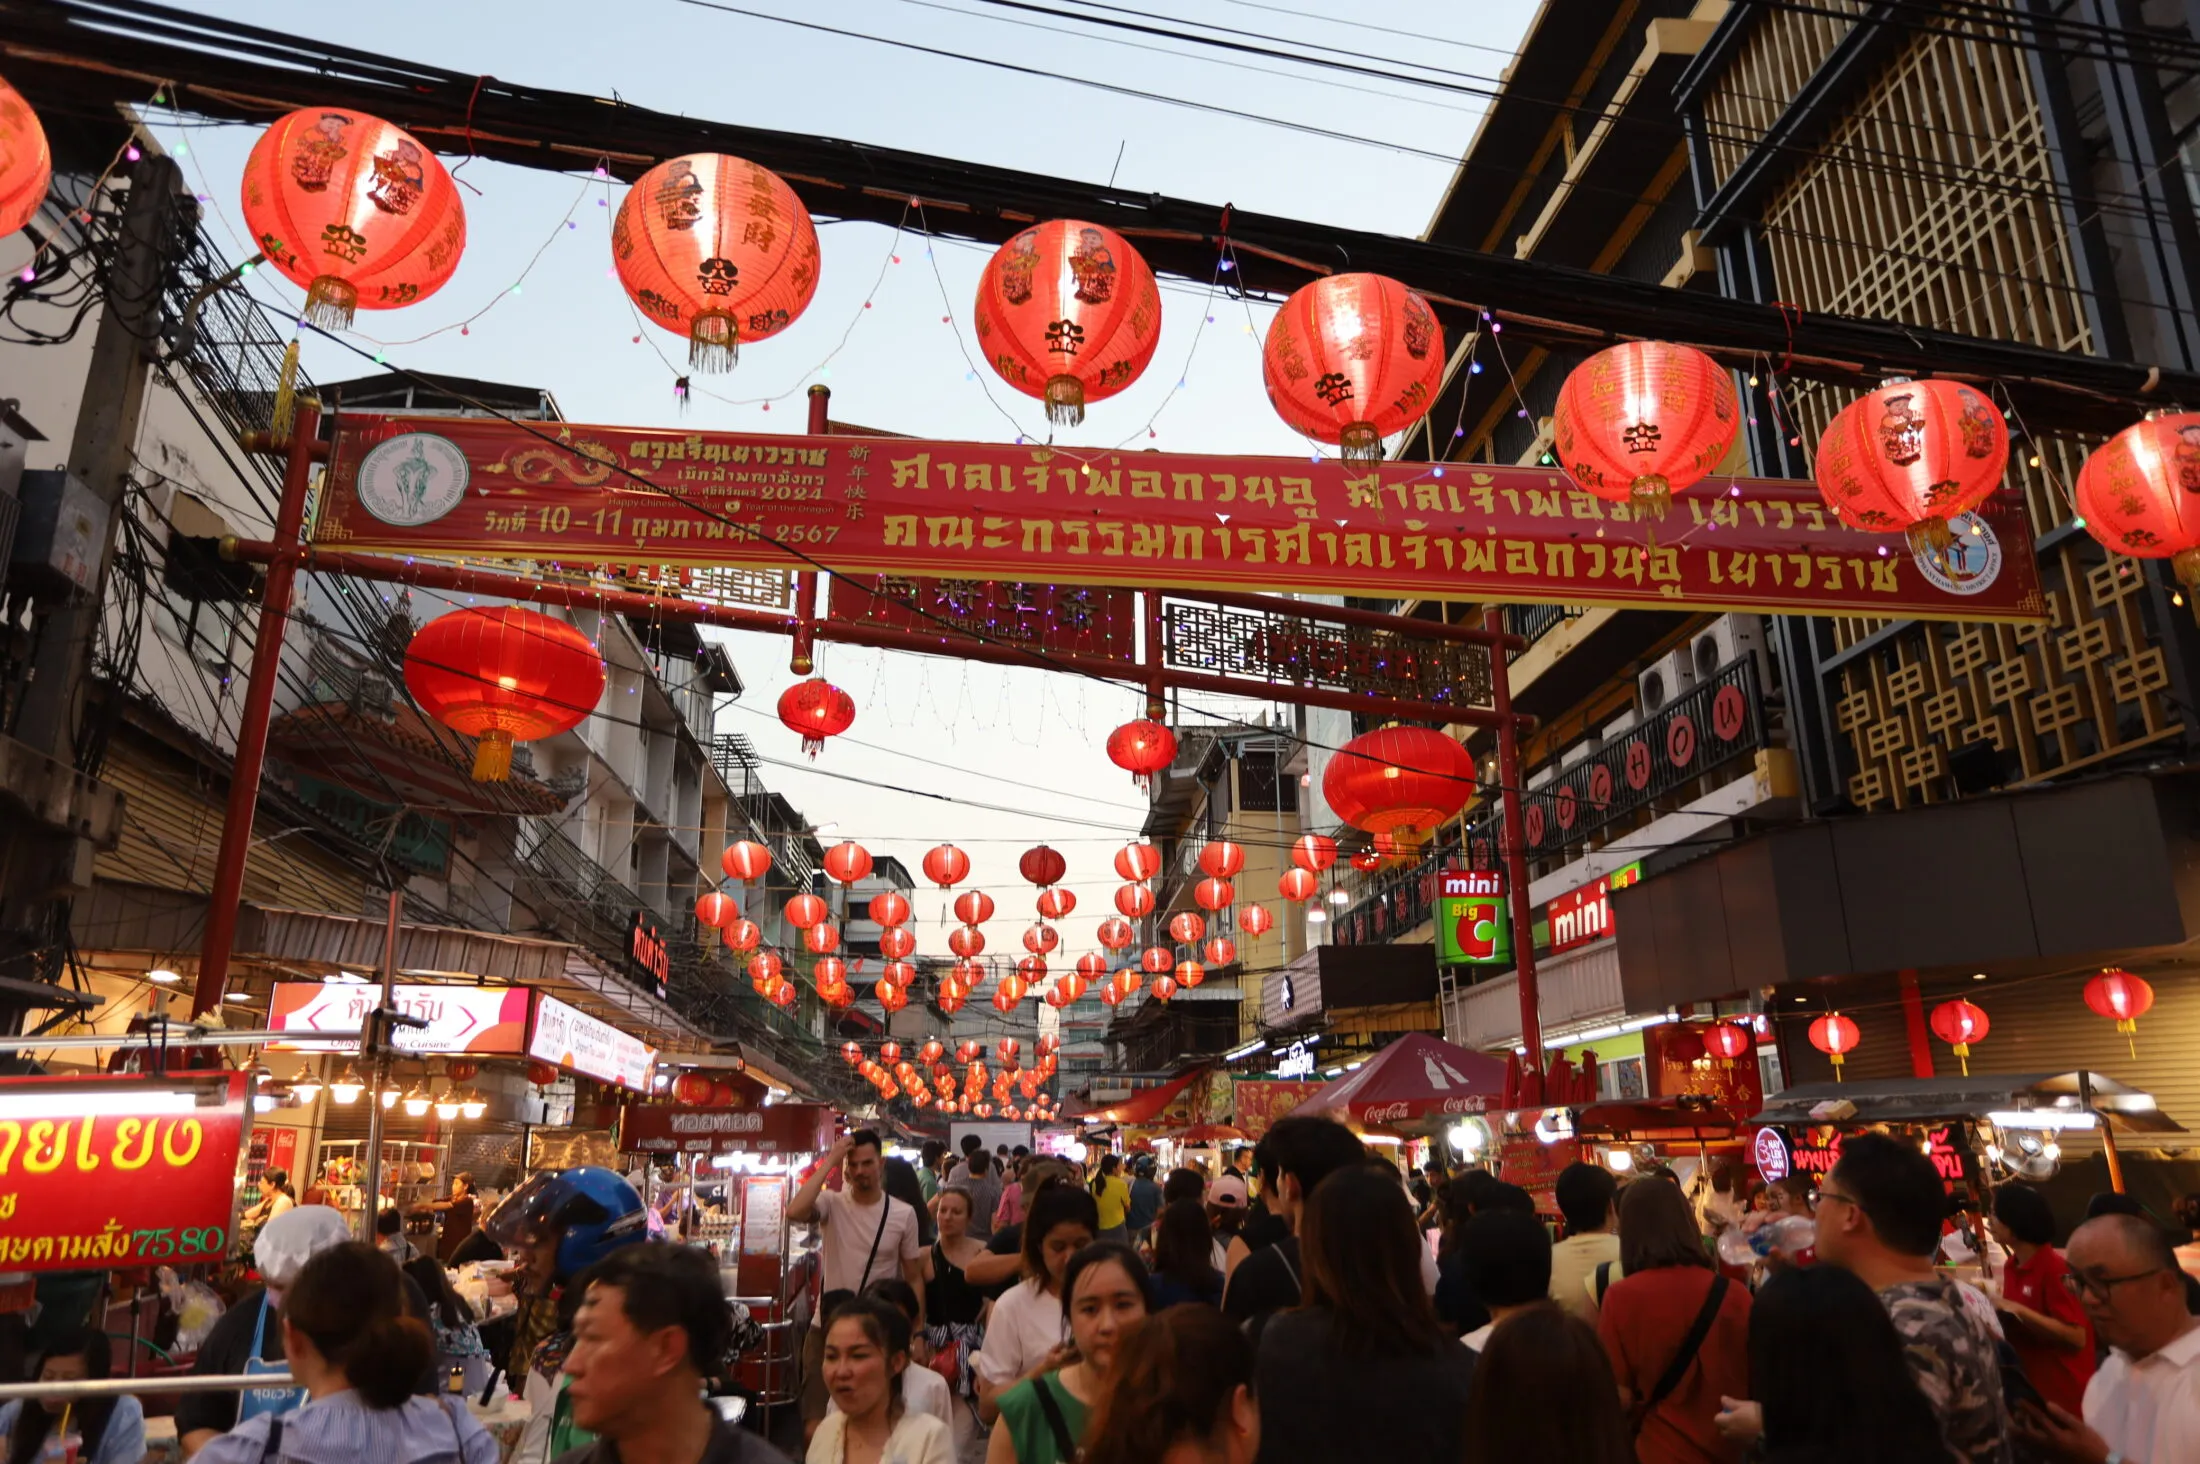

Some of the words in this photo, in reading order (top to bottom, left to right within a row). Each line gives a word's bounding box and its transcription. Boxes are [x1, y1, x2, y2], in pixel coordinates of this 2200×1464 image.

[760, 485, 825, 501] 2024
[889, 452, 1319, 519] ศาลเจ้าพ่อกวนอู
[608, 498, 640, 511] Happy
[641, 498, 678, 509] Chinese
[703, 501, 721, 511] Year
[800, 507, 835, 516] Dragon
[484, 505, 528, 533] วันที่
[775, 524, 841, 544] 2567
[1707, 549, 1900, 593] เยาวราช
[1445, 873, 1499, 893] mini
[1614, 874, 1628, 888] Big
[1452, 903, 1478, 921] Big
[1554, 881, 1607, 946] mini
[1364, 1102, 1409, 1121] Coca-Cola
[1443, 1095, 1486, 1112] Coca-Cola
